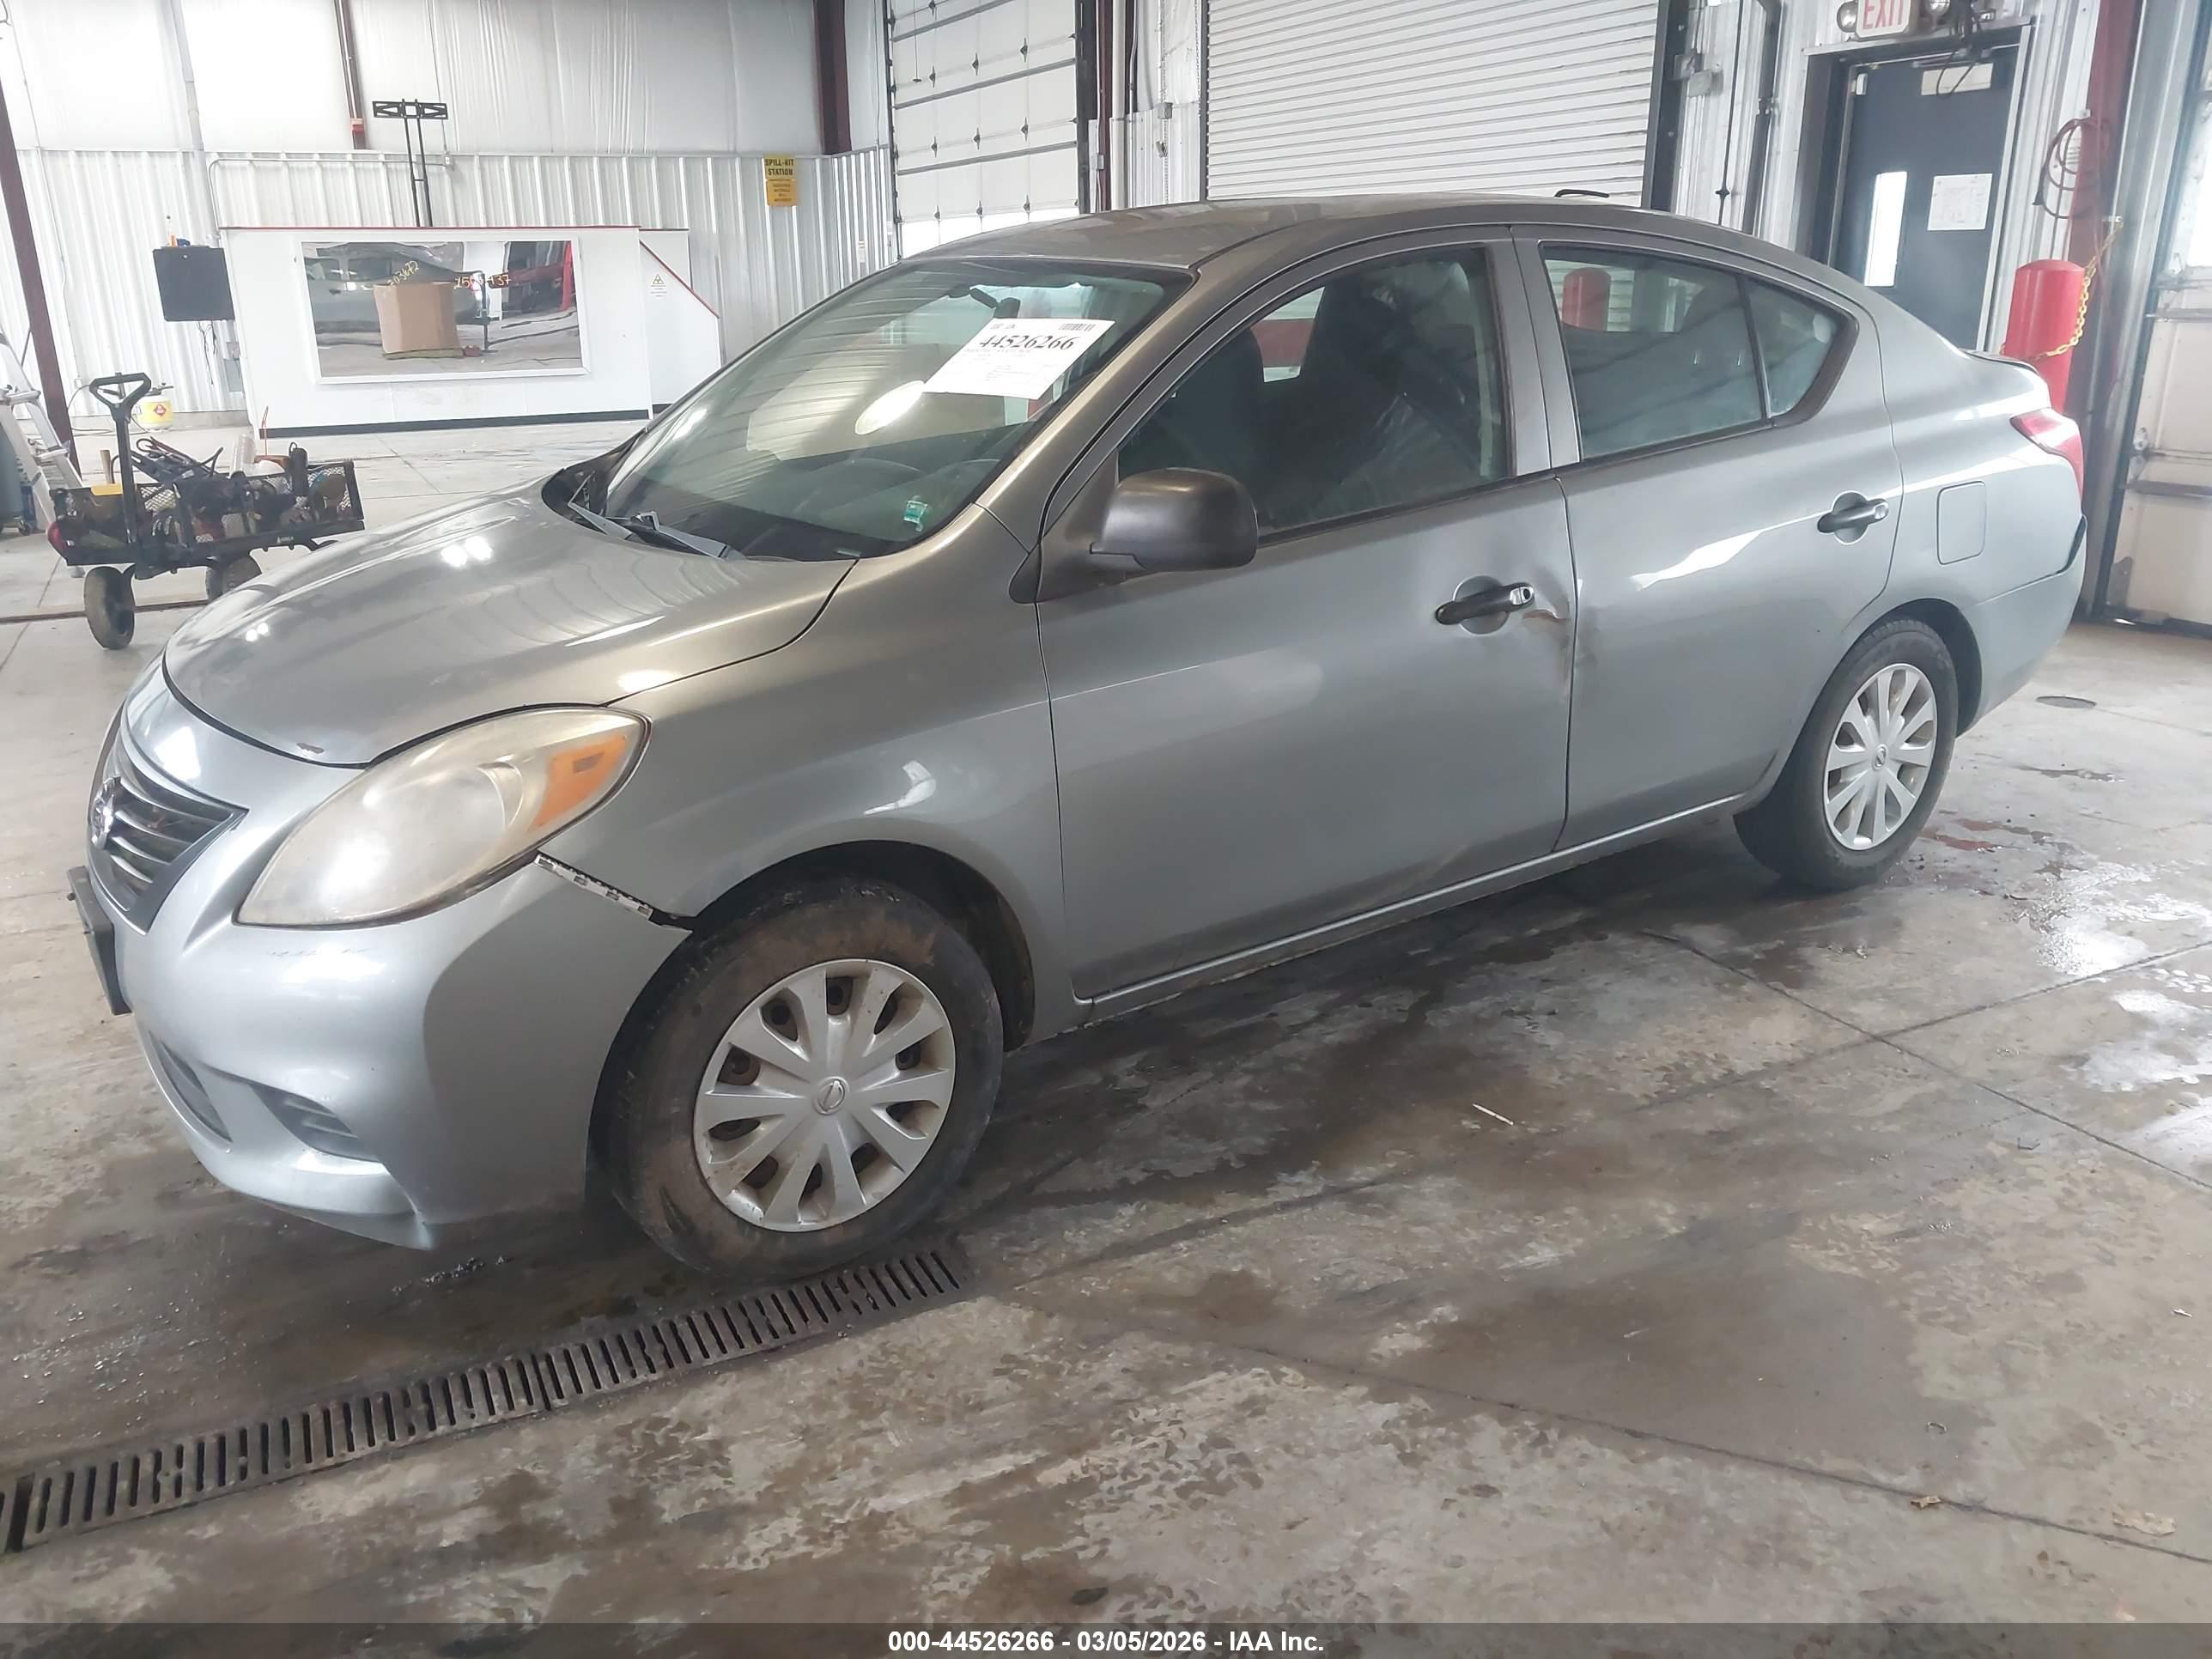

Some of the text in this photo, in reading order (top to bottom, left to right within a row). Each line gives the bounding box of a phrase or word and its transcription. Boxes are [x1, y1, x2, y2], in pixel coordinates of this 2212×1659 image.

[1863, 0, 1904, 29] EXIT
[764, 158, 794, 167] SPILL-KIT
[979, 335, 1081, 350] 44526266
